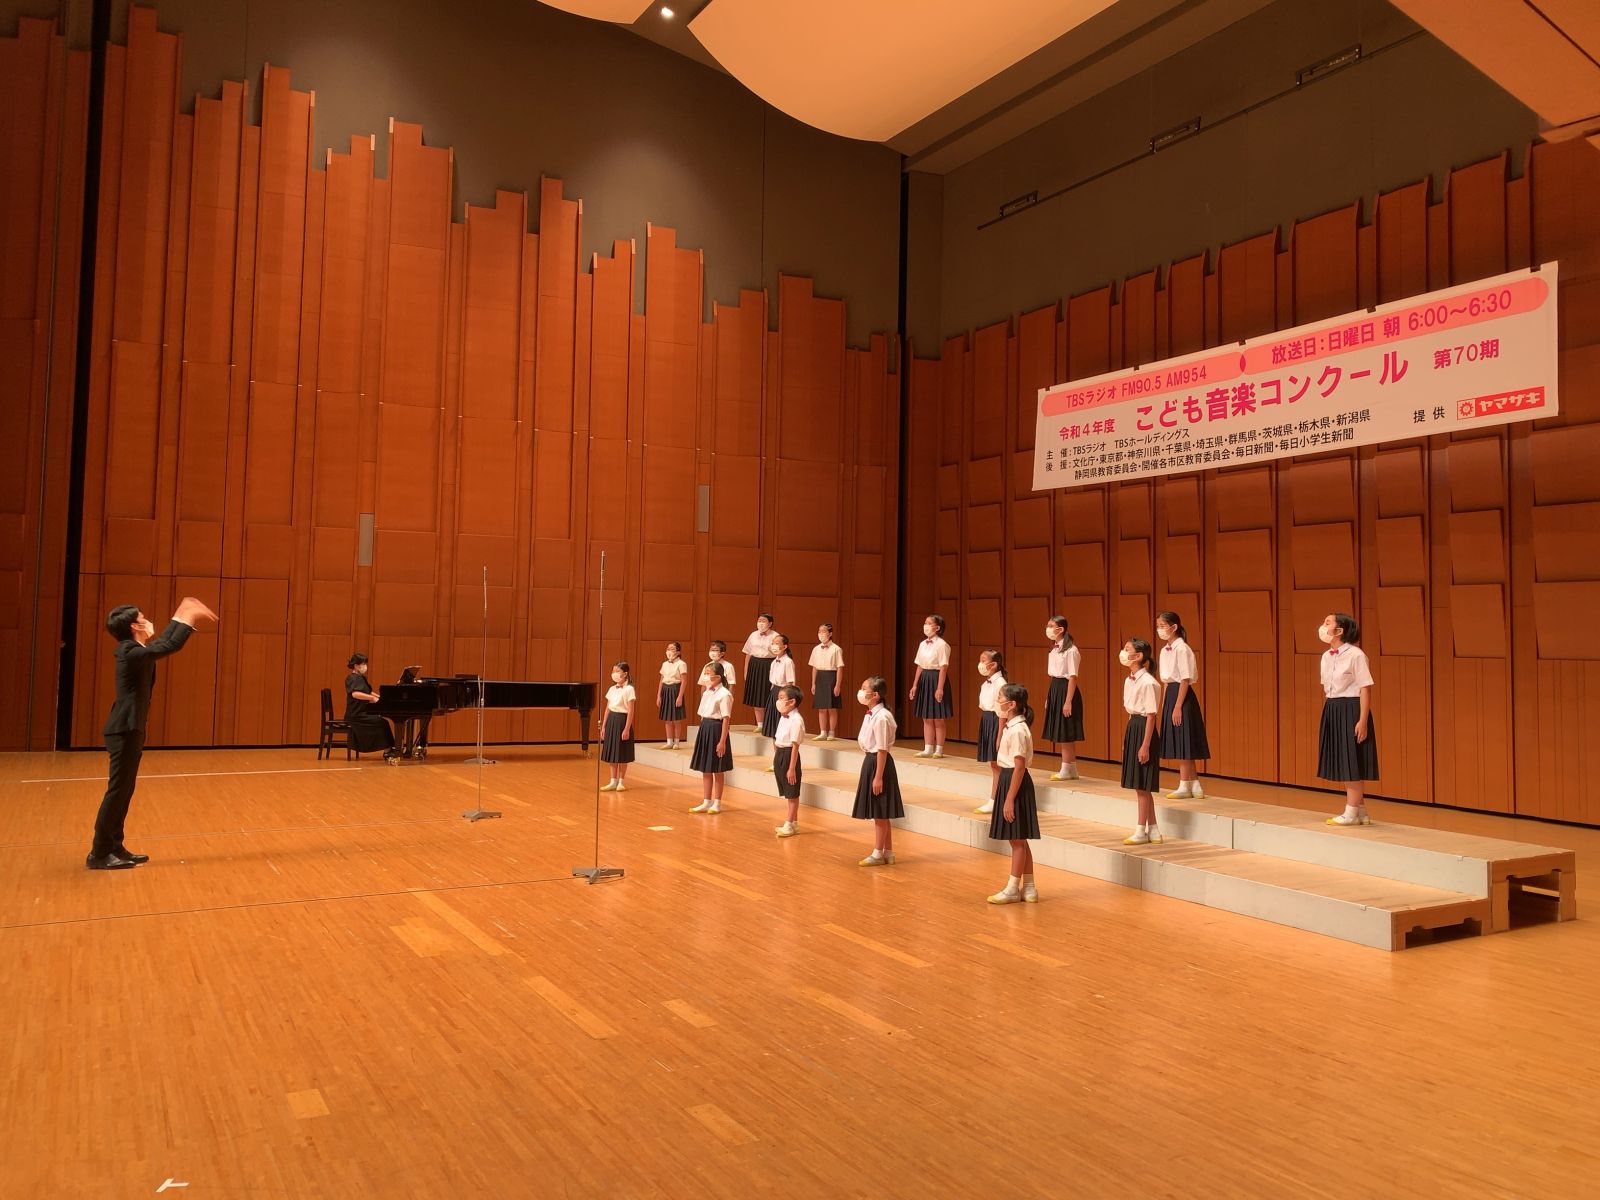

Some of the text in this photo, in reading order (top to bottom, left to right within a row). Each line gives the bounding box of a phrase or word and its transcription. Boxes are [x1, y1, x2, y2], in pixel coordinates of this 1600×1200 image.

[1383, 316, 1400, 338] 朝
[1059, 339, 1500, 441] 令和4年度 こども音楽コンクール 第70期
[1066, 365, 1207, 409] TBSラジオ FM90.5 AM954
[1479, 392, 1541, 412] ヤマザキ
